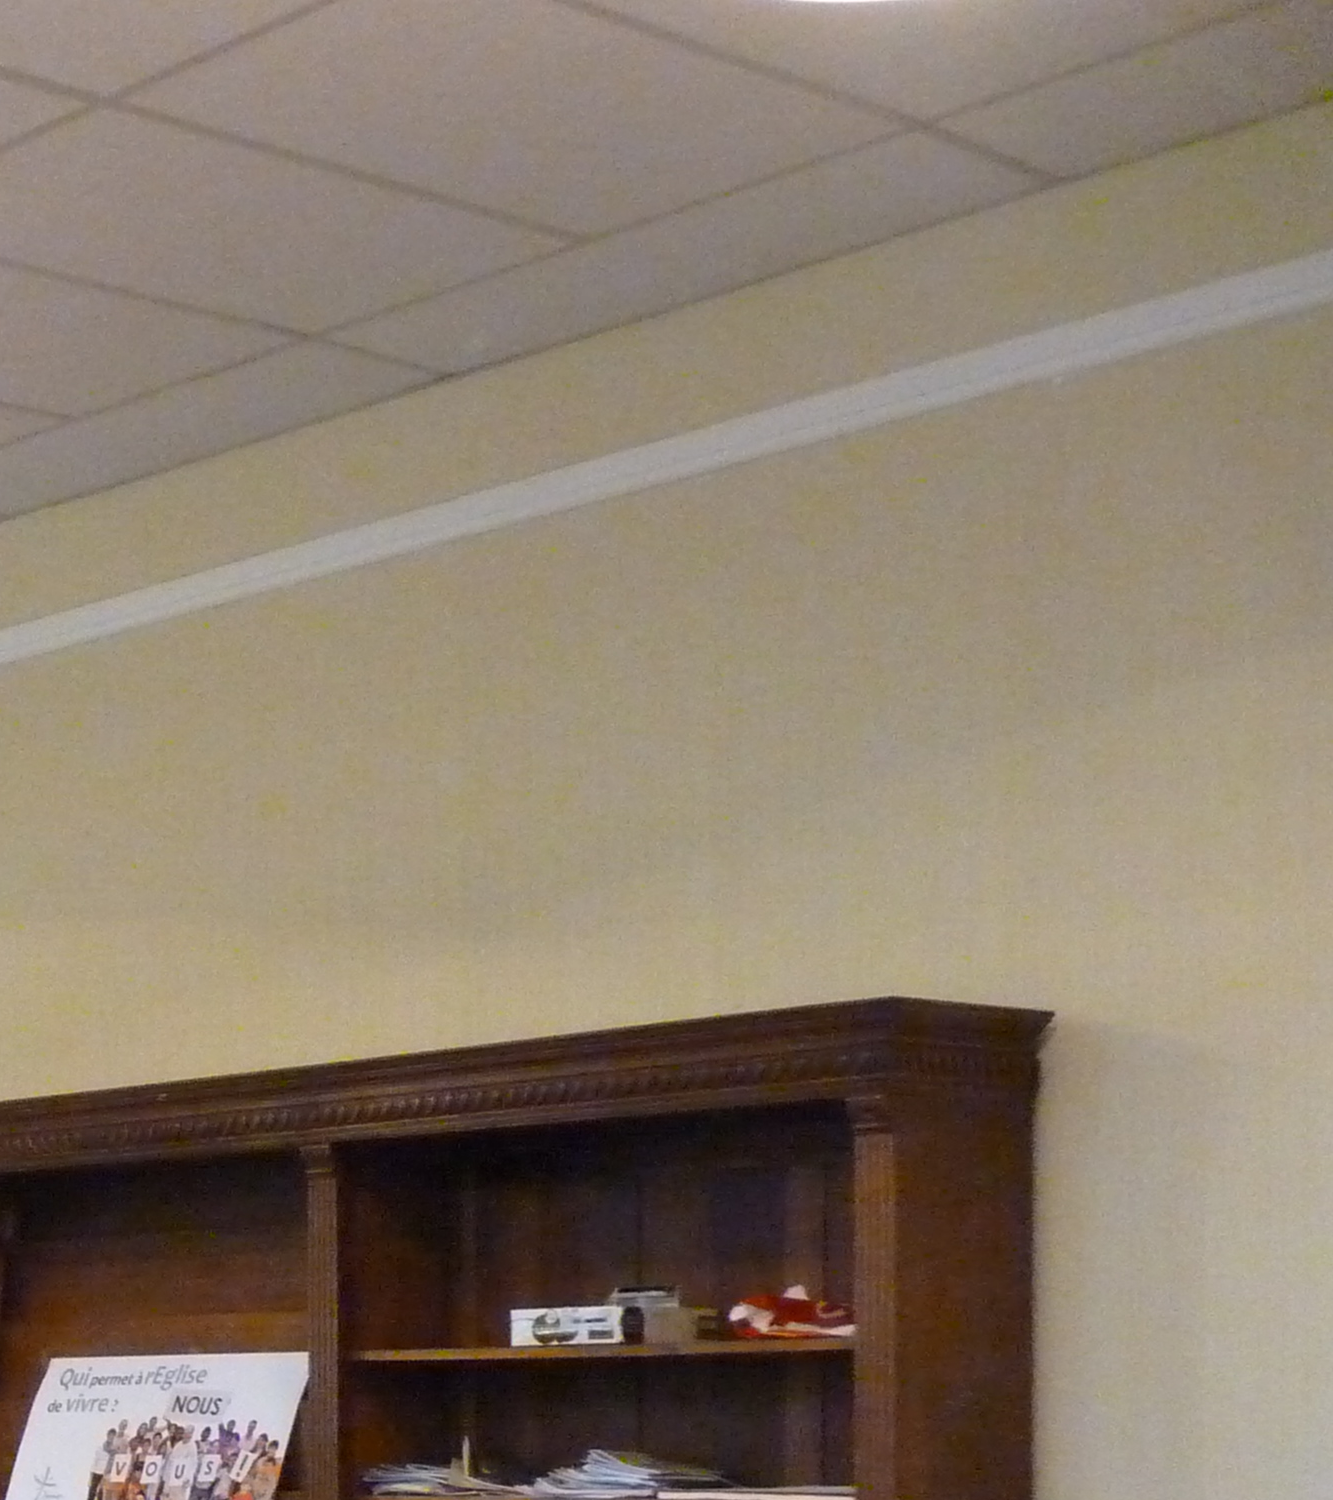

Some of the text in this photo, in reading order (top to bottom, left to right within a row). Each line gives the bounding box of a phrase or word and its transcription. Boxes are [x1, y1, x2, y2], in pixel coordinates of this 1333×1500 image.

[60, 1367, 93, 1390] Qui
[89, 1374, 133, 1388] permet
[47, 1400, 63, 1413] de
[66, 1394, 109, 1413] vivre
[171, 1395, 223, 1415] NOUS
